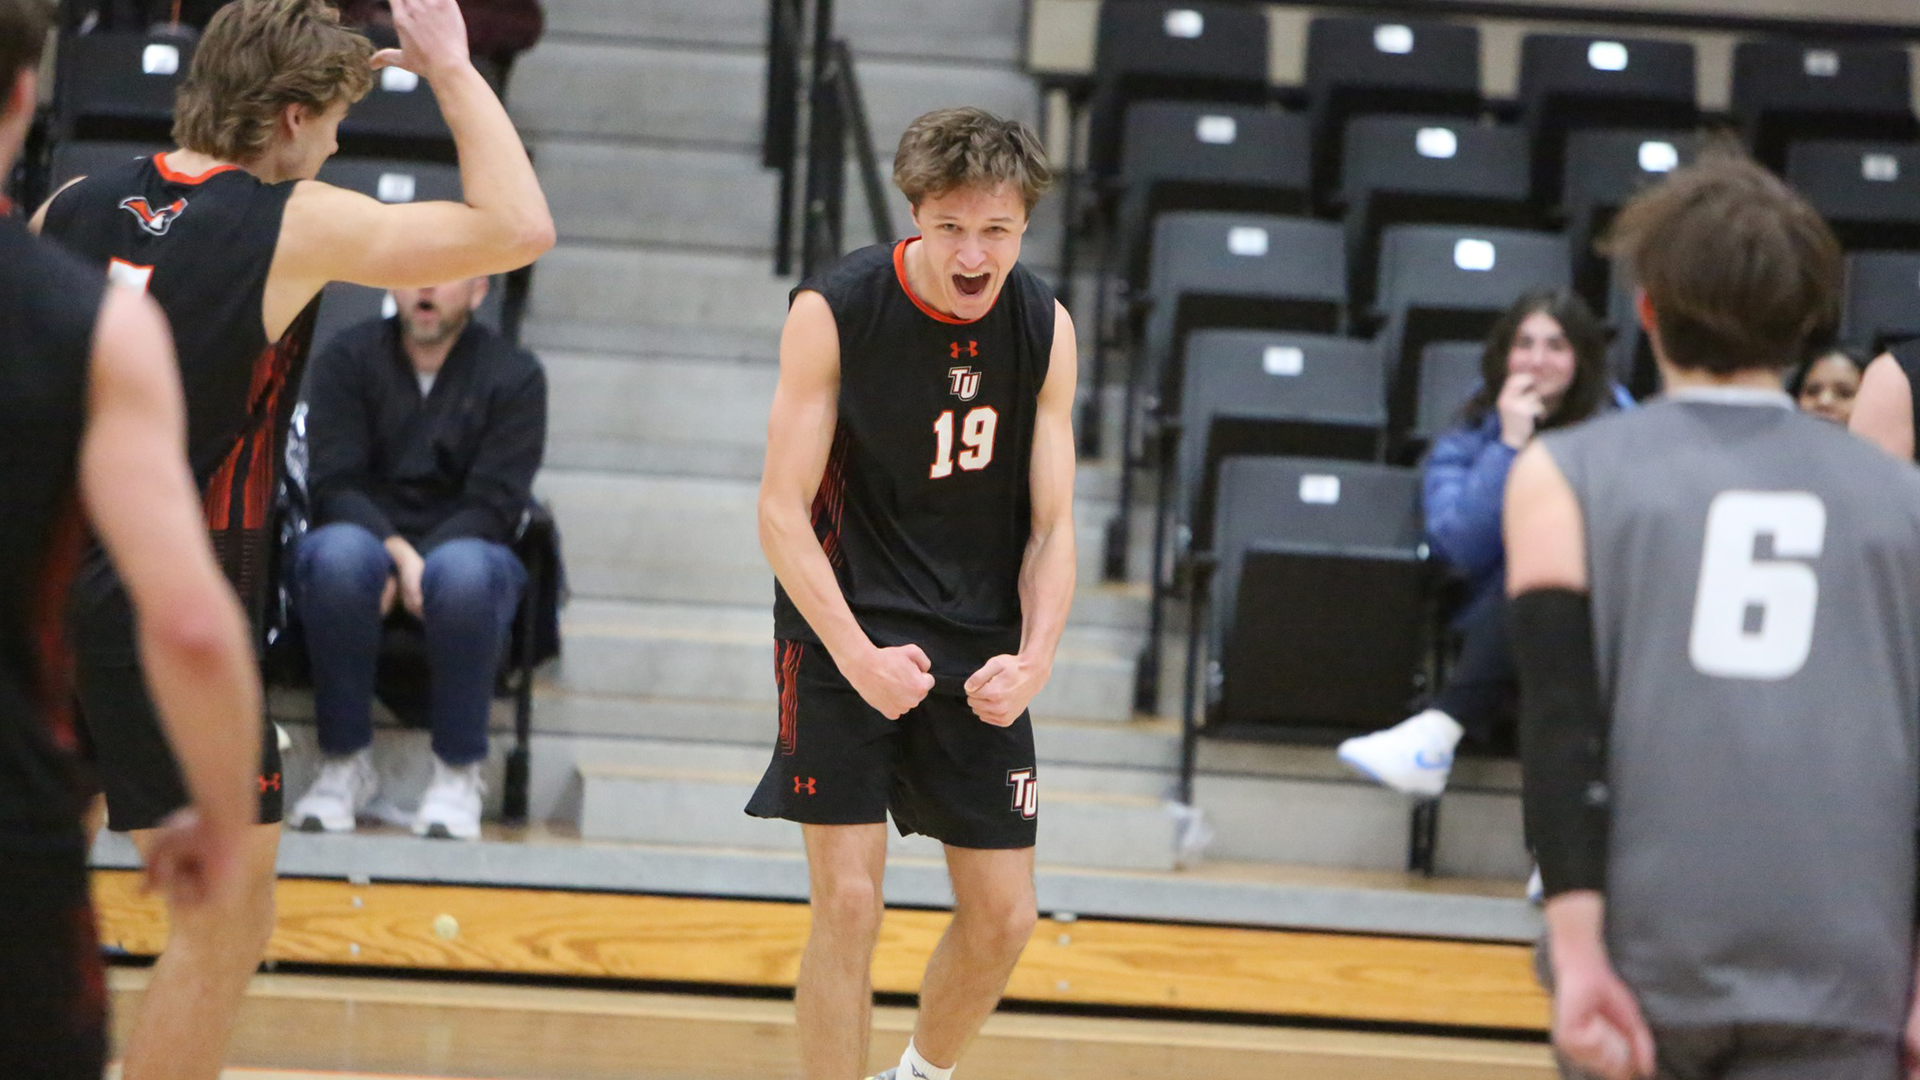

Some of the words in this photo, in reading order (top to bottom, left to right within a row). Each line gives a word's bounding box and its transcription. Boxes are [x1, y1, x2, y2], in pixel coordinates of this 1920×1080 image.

[949, 367, 981, 401] TU
[929, 405, 998, 479] 19
[1689, 490, 1826, 679] 6
[1007, 767, 1037, 819] TU
